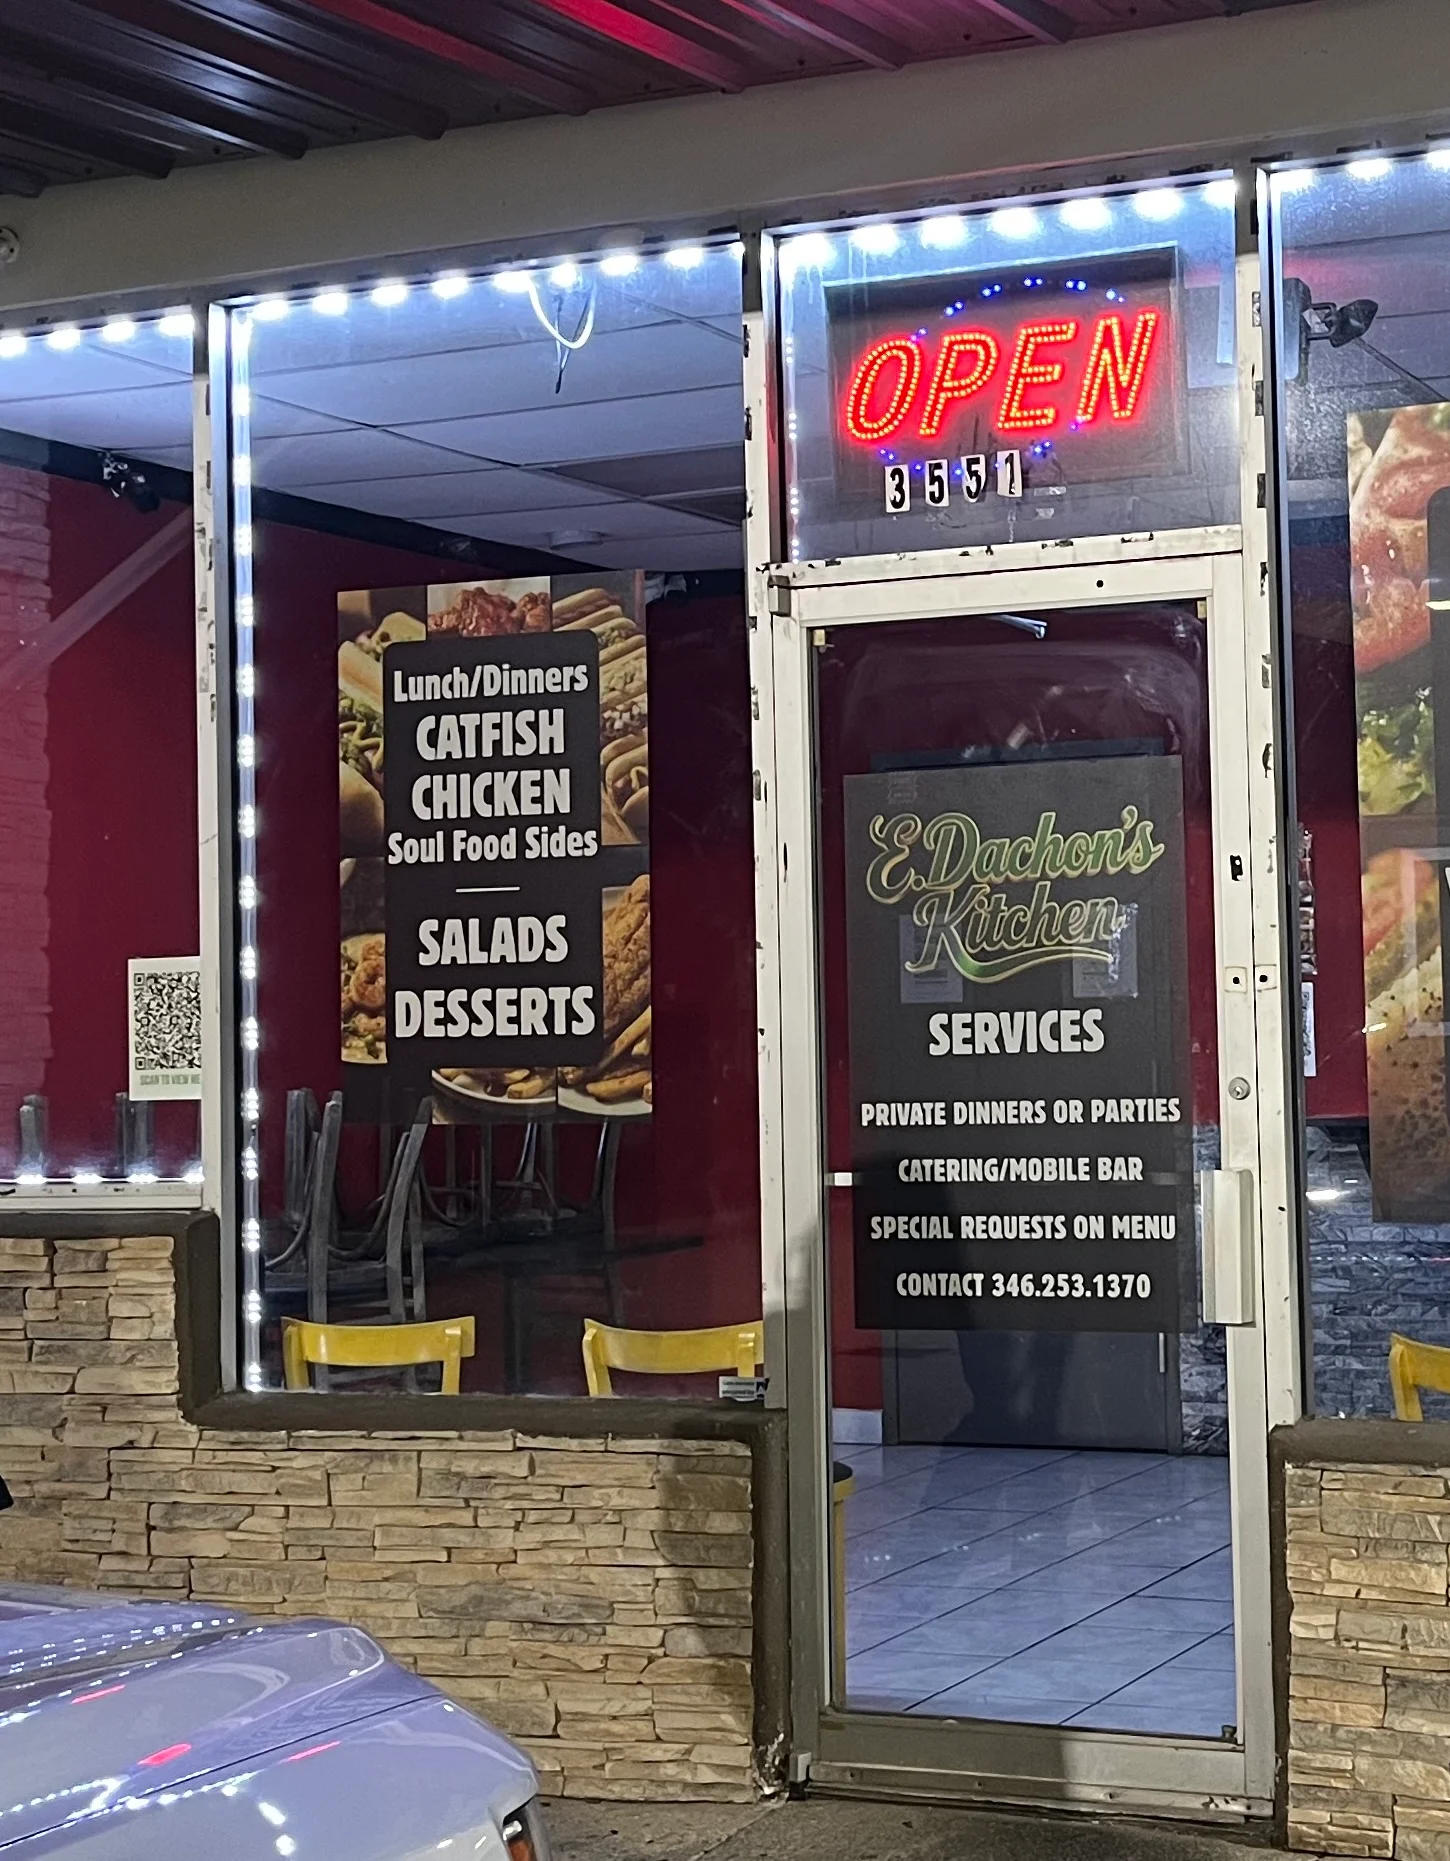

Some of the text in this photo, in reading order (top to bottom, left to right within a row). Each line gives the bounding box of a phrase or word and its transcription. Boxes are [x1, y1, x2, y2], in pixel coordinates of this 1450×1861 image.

[846, 311, 1158, 440] OPEN
[888, 451, 1017, 510] 3551
[393, 664, 589, 703] Lunch/Dinners
[416, 708, 564, 761] CATFISH
[411, 768, 571, 821] CHICKEN
[388, 825, 598, 865] Soul Food Sides
[866, 805, 1165, 904] E.Dachon's
[418, 915, 569, 966] SALADS
[904, 880, 1121, 983] Kitchen
[394, 986, 596, 1038] DESSERTS
[928, 1008, 1105, 1056] SERVICES
[861, 1097, 1181, 1126] PRIVATE DINNERS OR PARTIES
[899, 1157, 1143, 1182] CATERING/MOBILE BAR
[870, 1215, 1176, 1240] SPECIAL REQUESTS ON MENU
[896, 1273, 1151, 1298] CONTACT 346.253.1370
